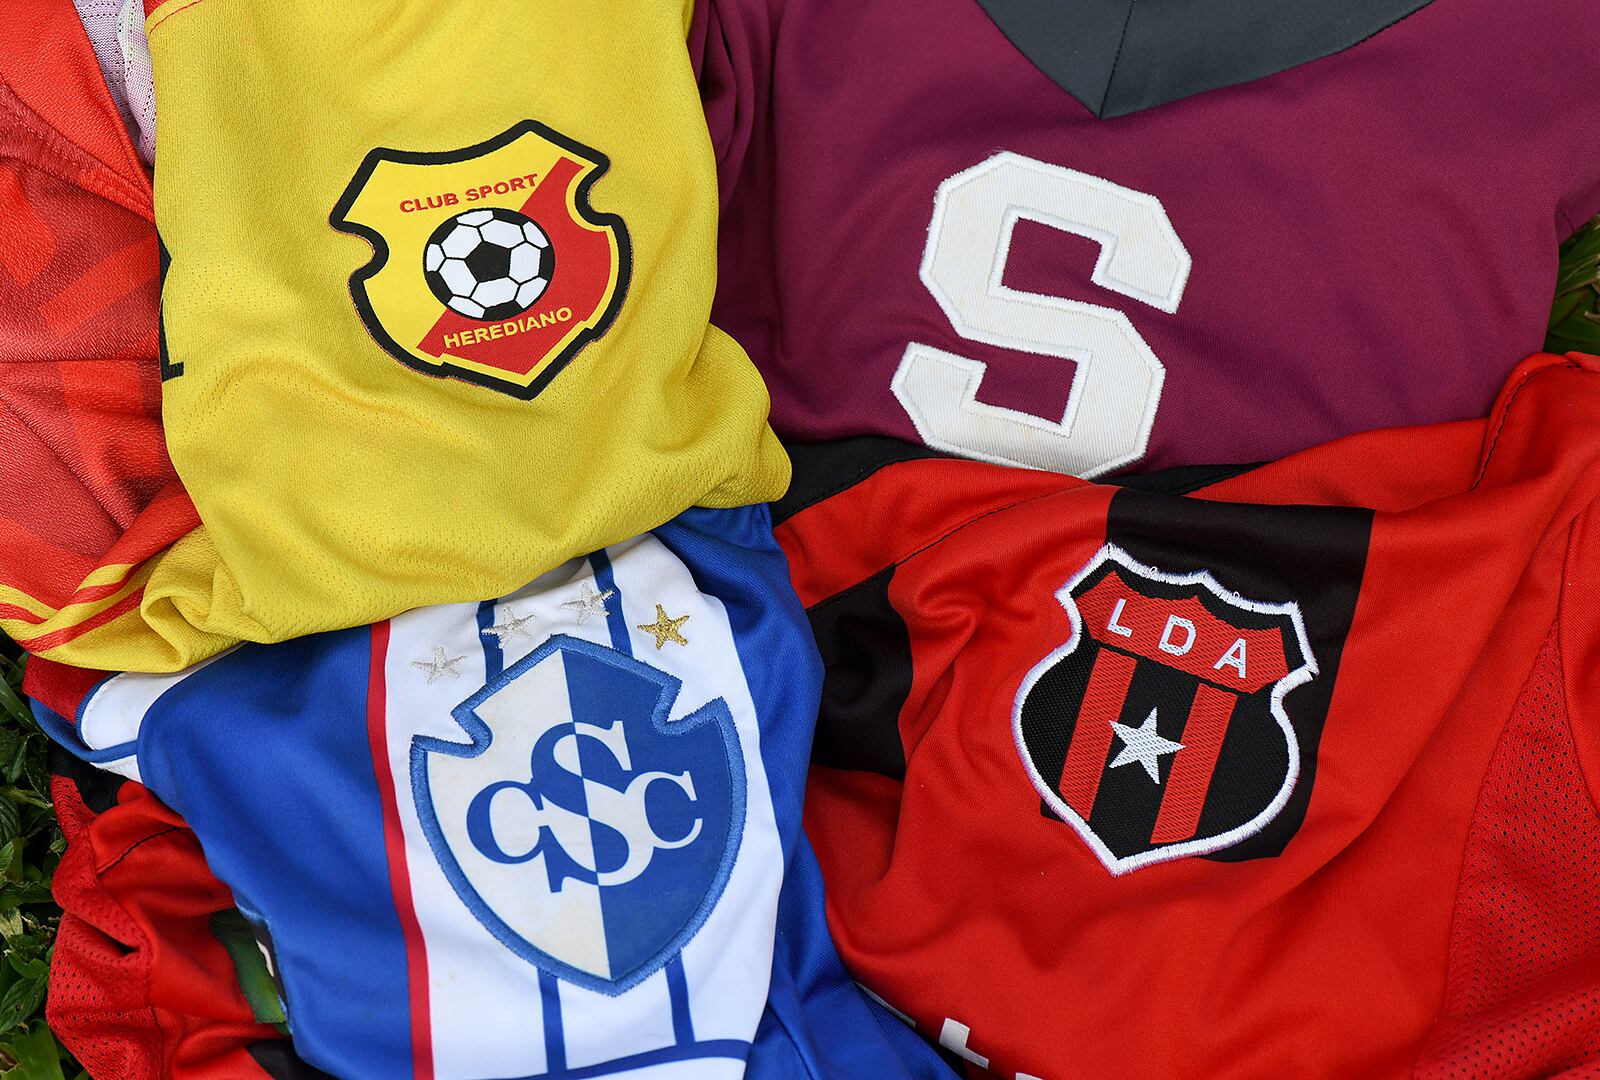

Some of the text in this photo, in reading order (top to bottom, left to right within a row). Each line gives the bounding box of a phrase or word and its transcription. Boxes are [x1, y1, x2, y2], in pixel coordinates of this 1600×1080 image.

[399, 173, 539, 214] CLUB SPORT
[443, 307, 573, 349] HEREDIANO
[890, 150, 1193, 479] S
[1106, 598, 1247, 679] LDA
